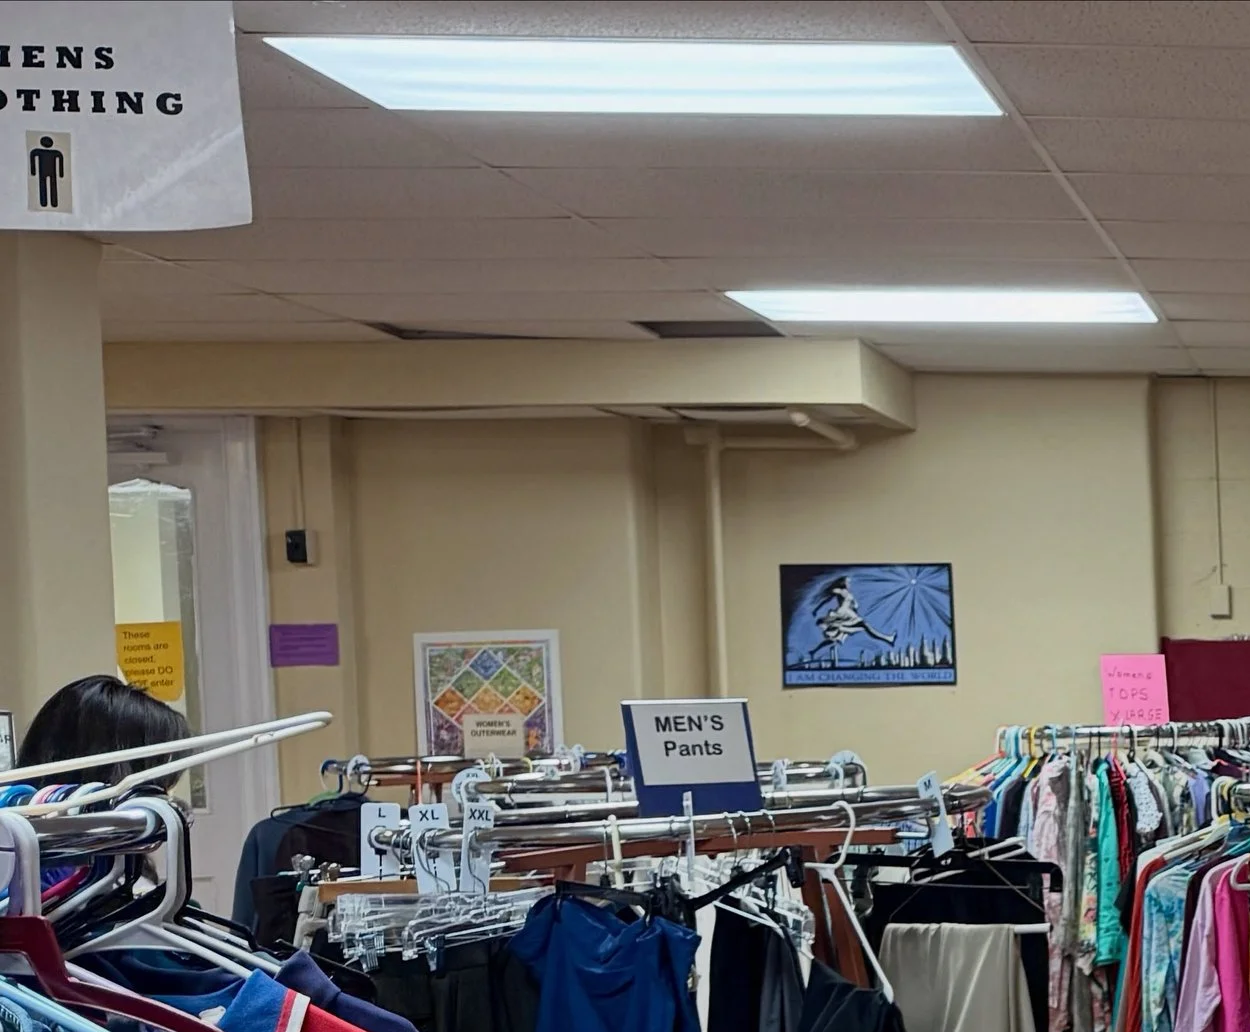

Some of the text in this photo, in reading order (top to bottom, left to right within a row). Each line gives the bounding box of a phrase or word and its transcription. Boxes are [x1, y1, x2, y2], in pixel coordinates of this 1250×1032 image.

[122, 631, 150, 640] These
[123, 644, 151, 652] rooms
[157, 666, 174, 674] DO
[796, 674, 815, 682] AM
[818, 673, 881, 682] CHANGING
[885, 673, 904, 681] THE
[910, 671, 953, 681] WORLD
[1109, 687, 1149, 701] TOPS
[1125, 708, 1163, 721] LARGE
[475, 720, 511, 728] WOMEN'S
[654, 715, 724, 733] MEN'S
[470, 729, 517, 737] OUTERWEAR
[663, 740, 723, 757] Pants
[378, 807, 386, 818] L
[419, 809, 440, 822] XL
[468, 808, 492, 821] XXL
